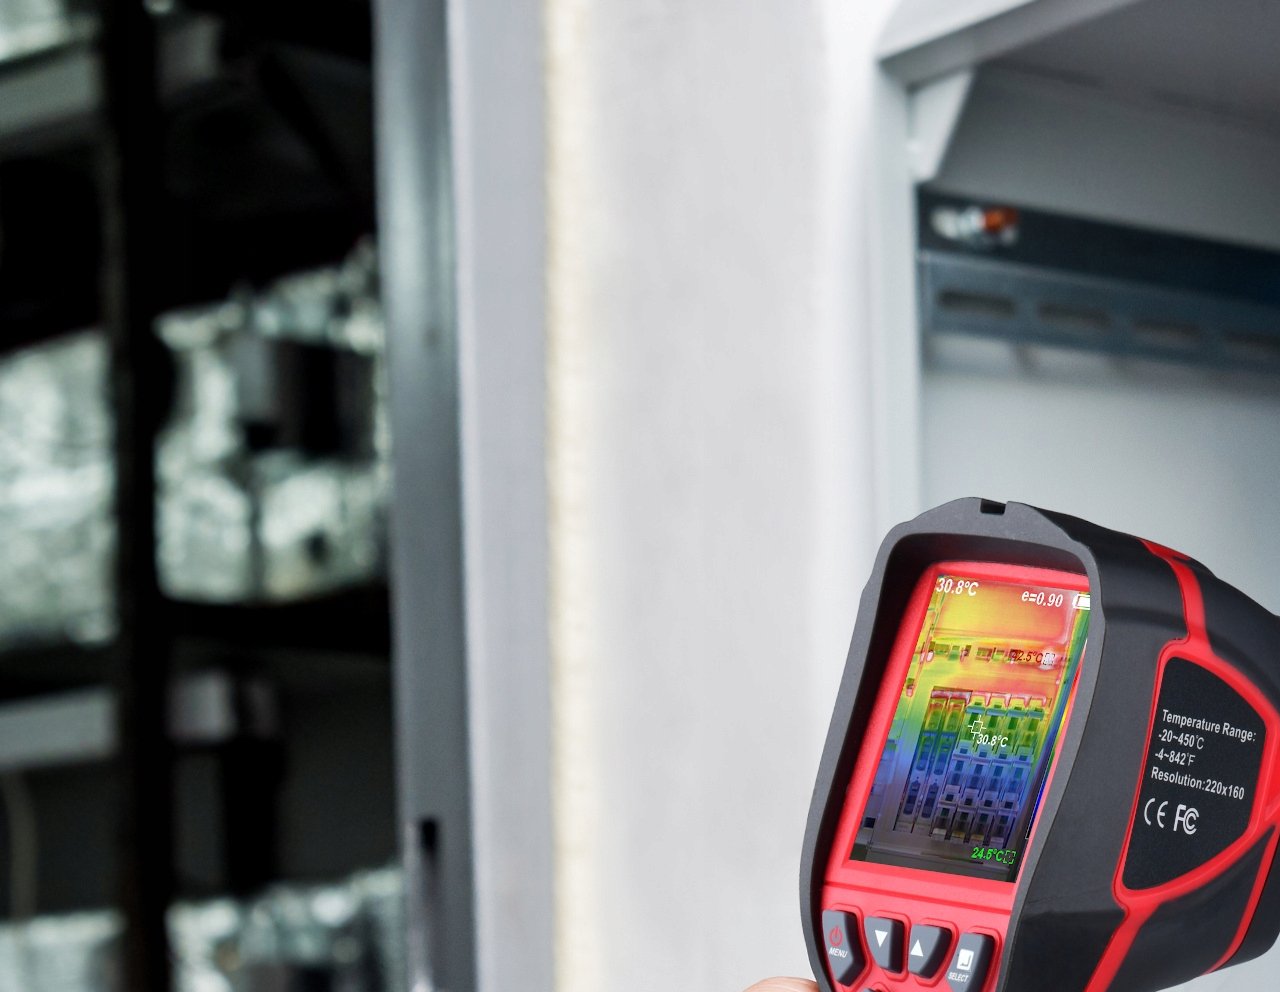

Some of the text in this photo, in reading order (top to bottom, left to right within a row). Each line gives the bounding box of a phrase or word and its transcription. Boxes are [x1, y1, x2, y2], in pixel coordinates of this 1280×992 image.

[936, 577, 979, 597] 30.8°C
[1021, 590, 1064, 608] e=0.90
[1162, 709, 1257, 743] Temperature Range:
[976, 733, 1009, 748] 30.8°C
[1151, 766, 1245, 800] Resolution:220x160
[1143, 797, 1169, 829] CE
[828, 947, 848, 959] MENU
[948, 971, 969, 983] SELECT
